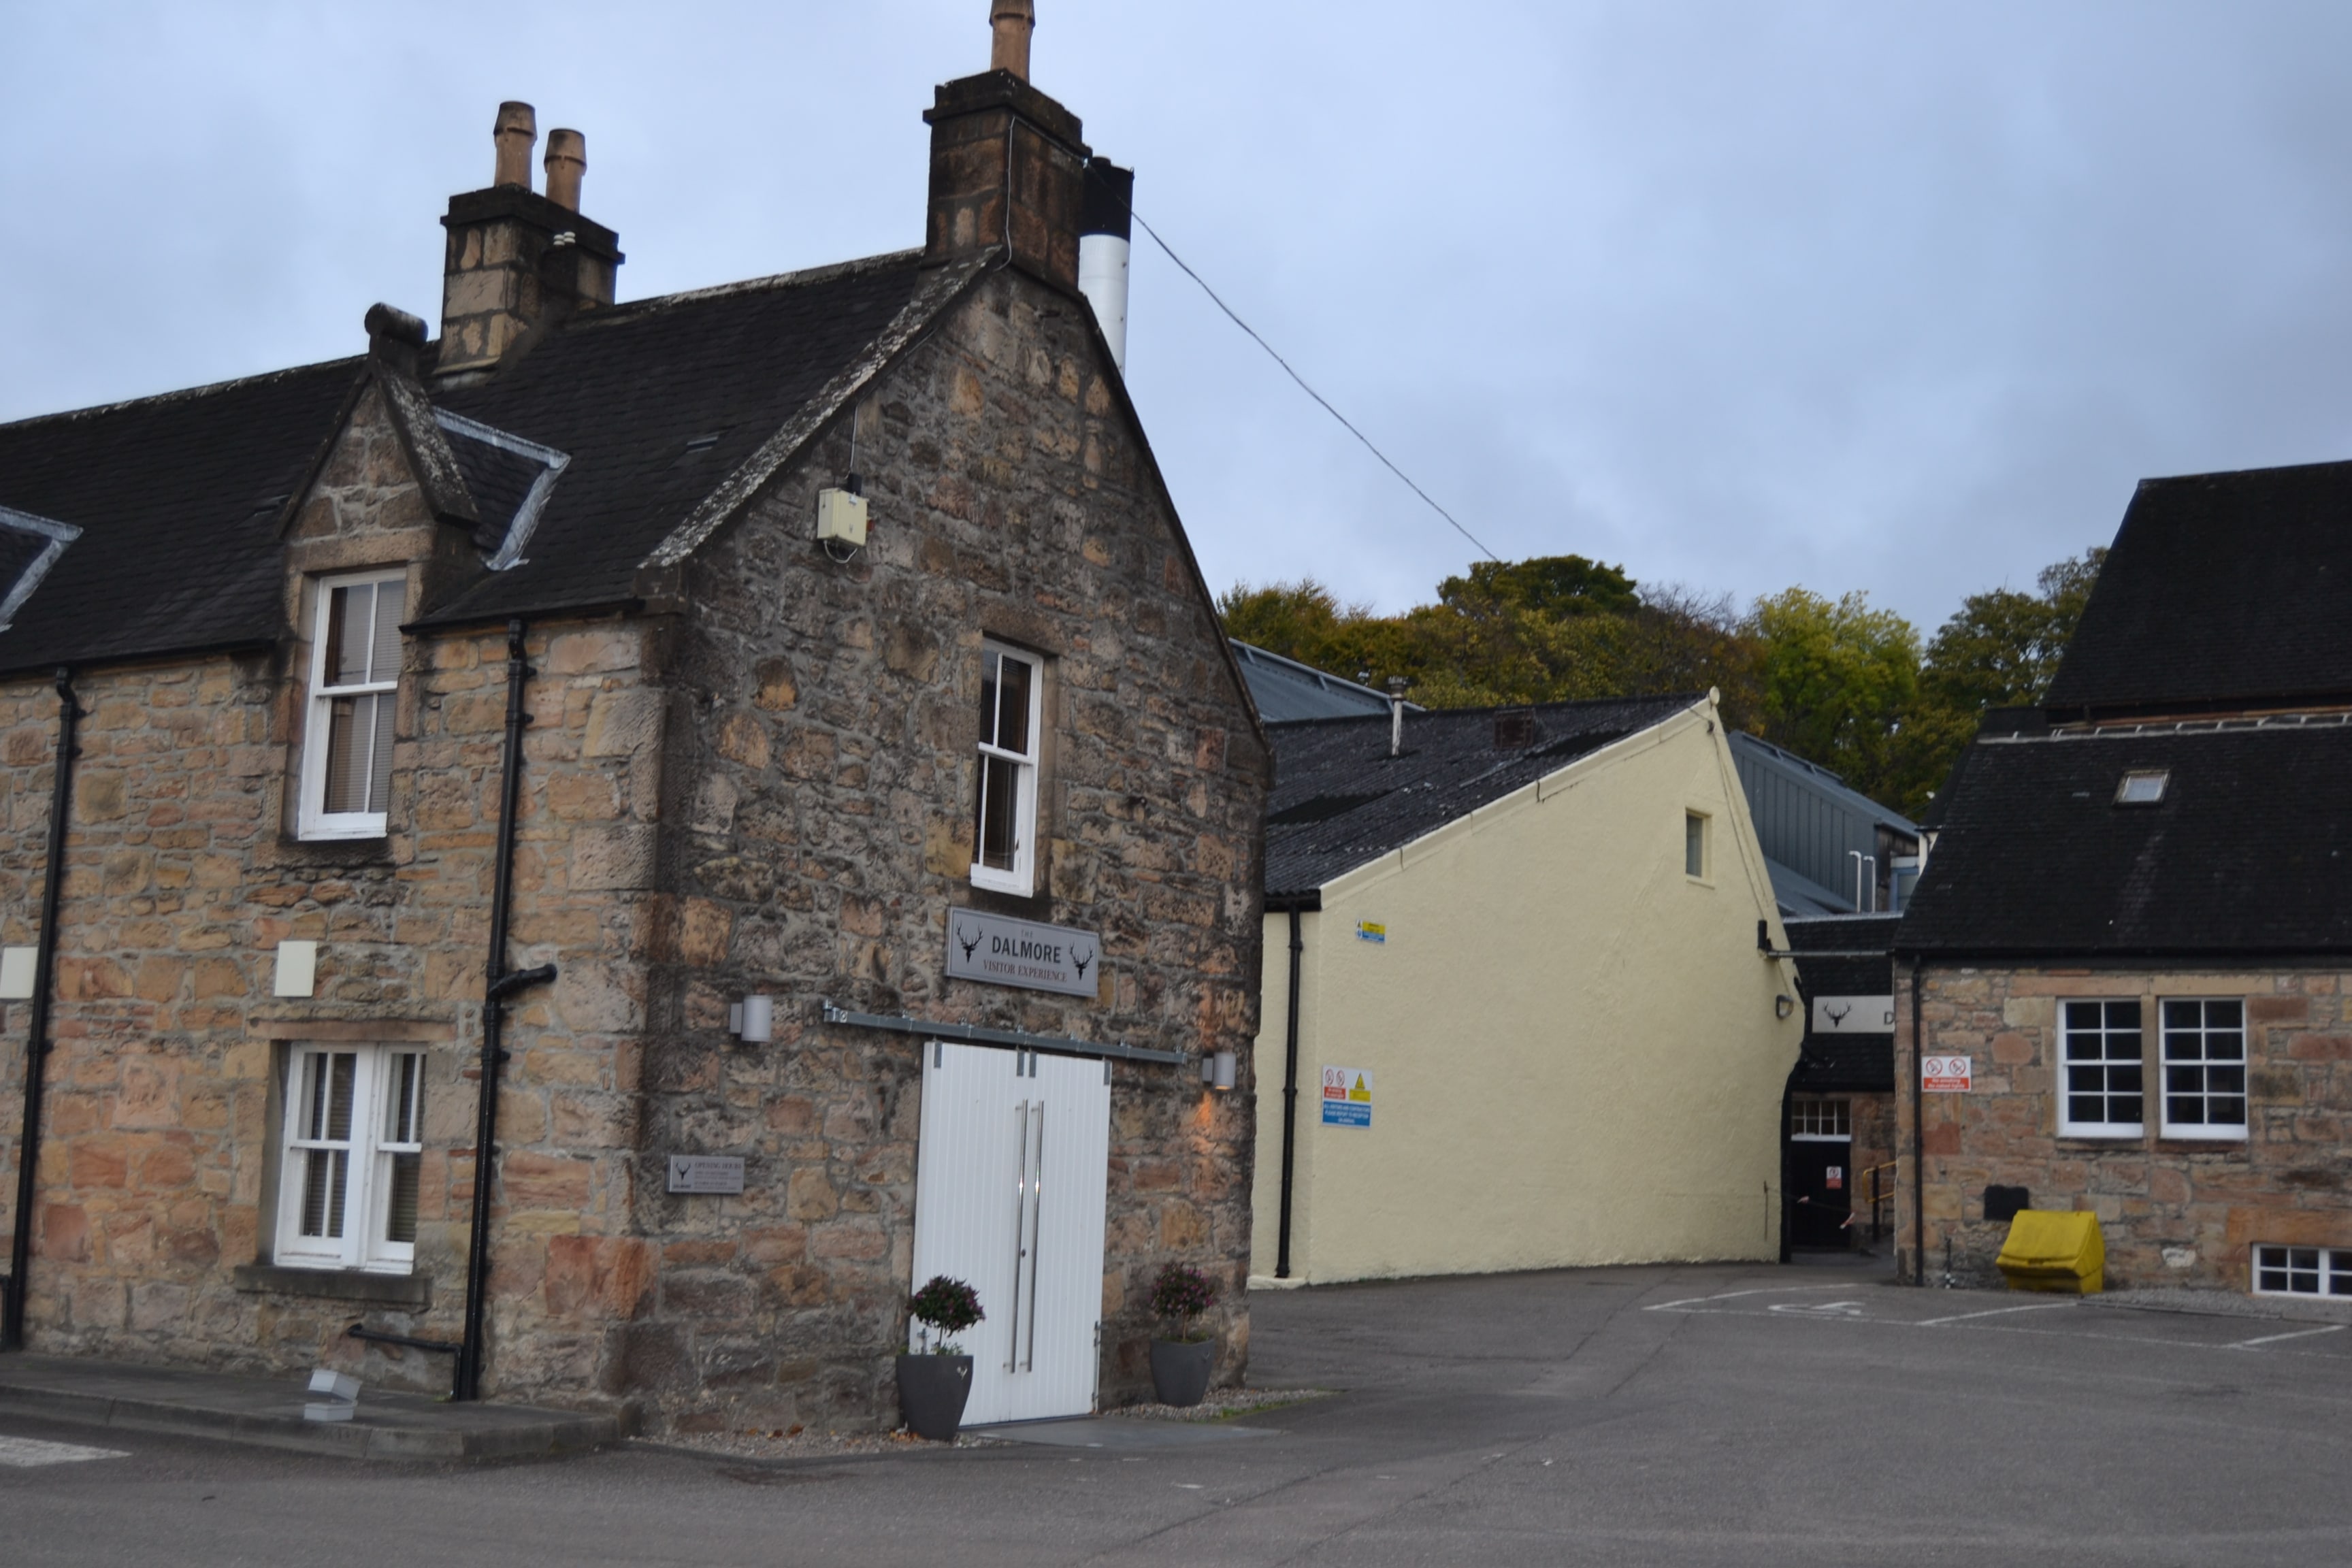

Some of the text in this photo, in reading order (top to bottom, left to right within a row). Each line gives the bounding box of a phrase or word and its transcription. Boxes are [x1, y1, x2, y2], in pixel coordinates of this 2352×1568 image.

[992, 936, 1061, 964] DALMORE
[983, 959, 1067, 982] VISITOR EXPERIENCE
